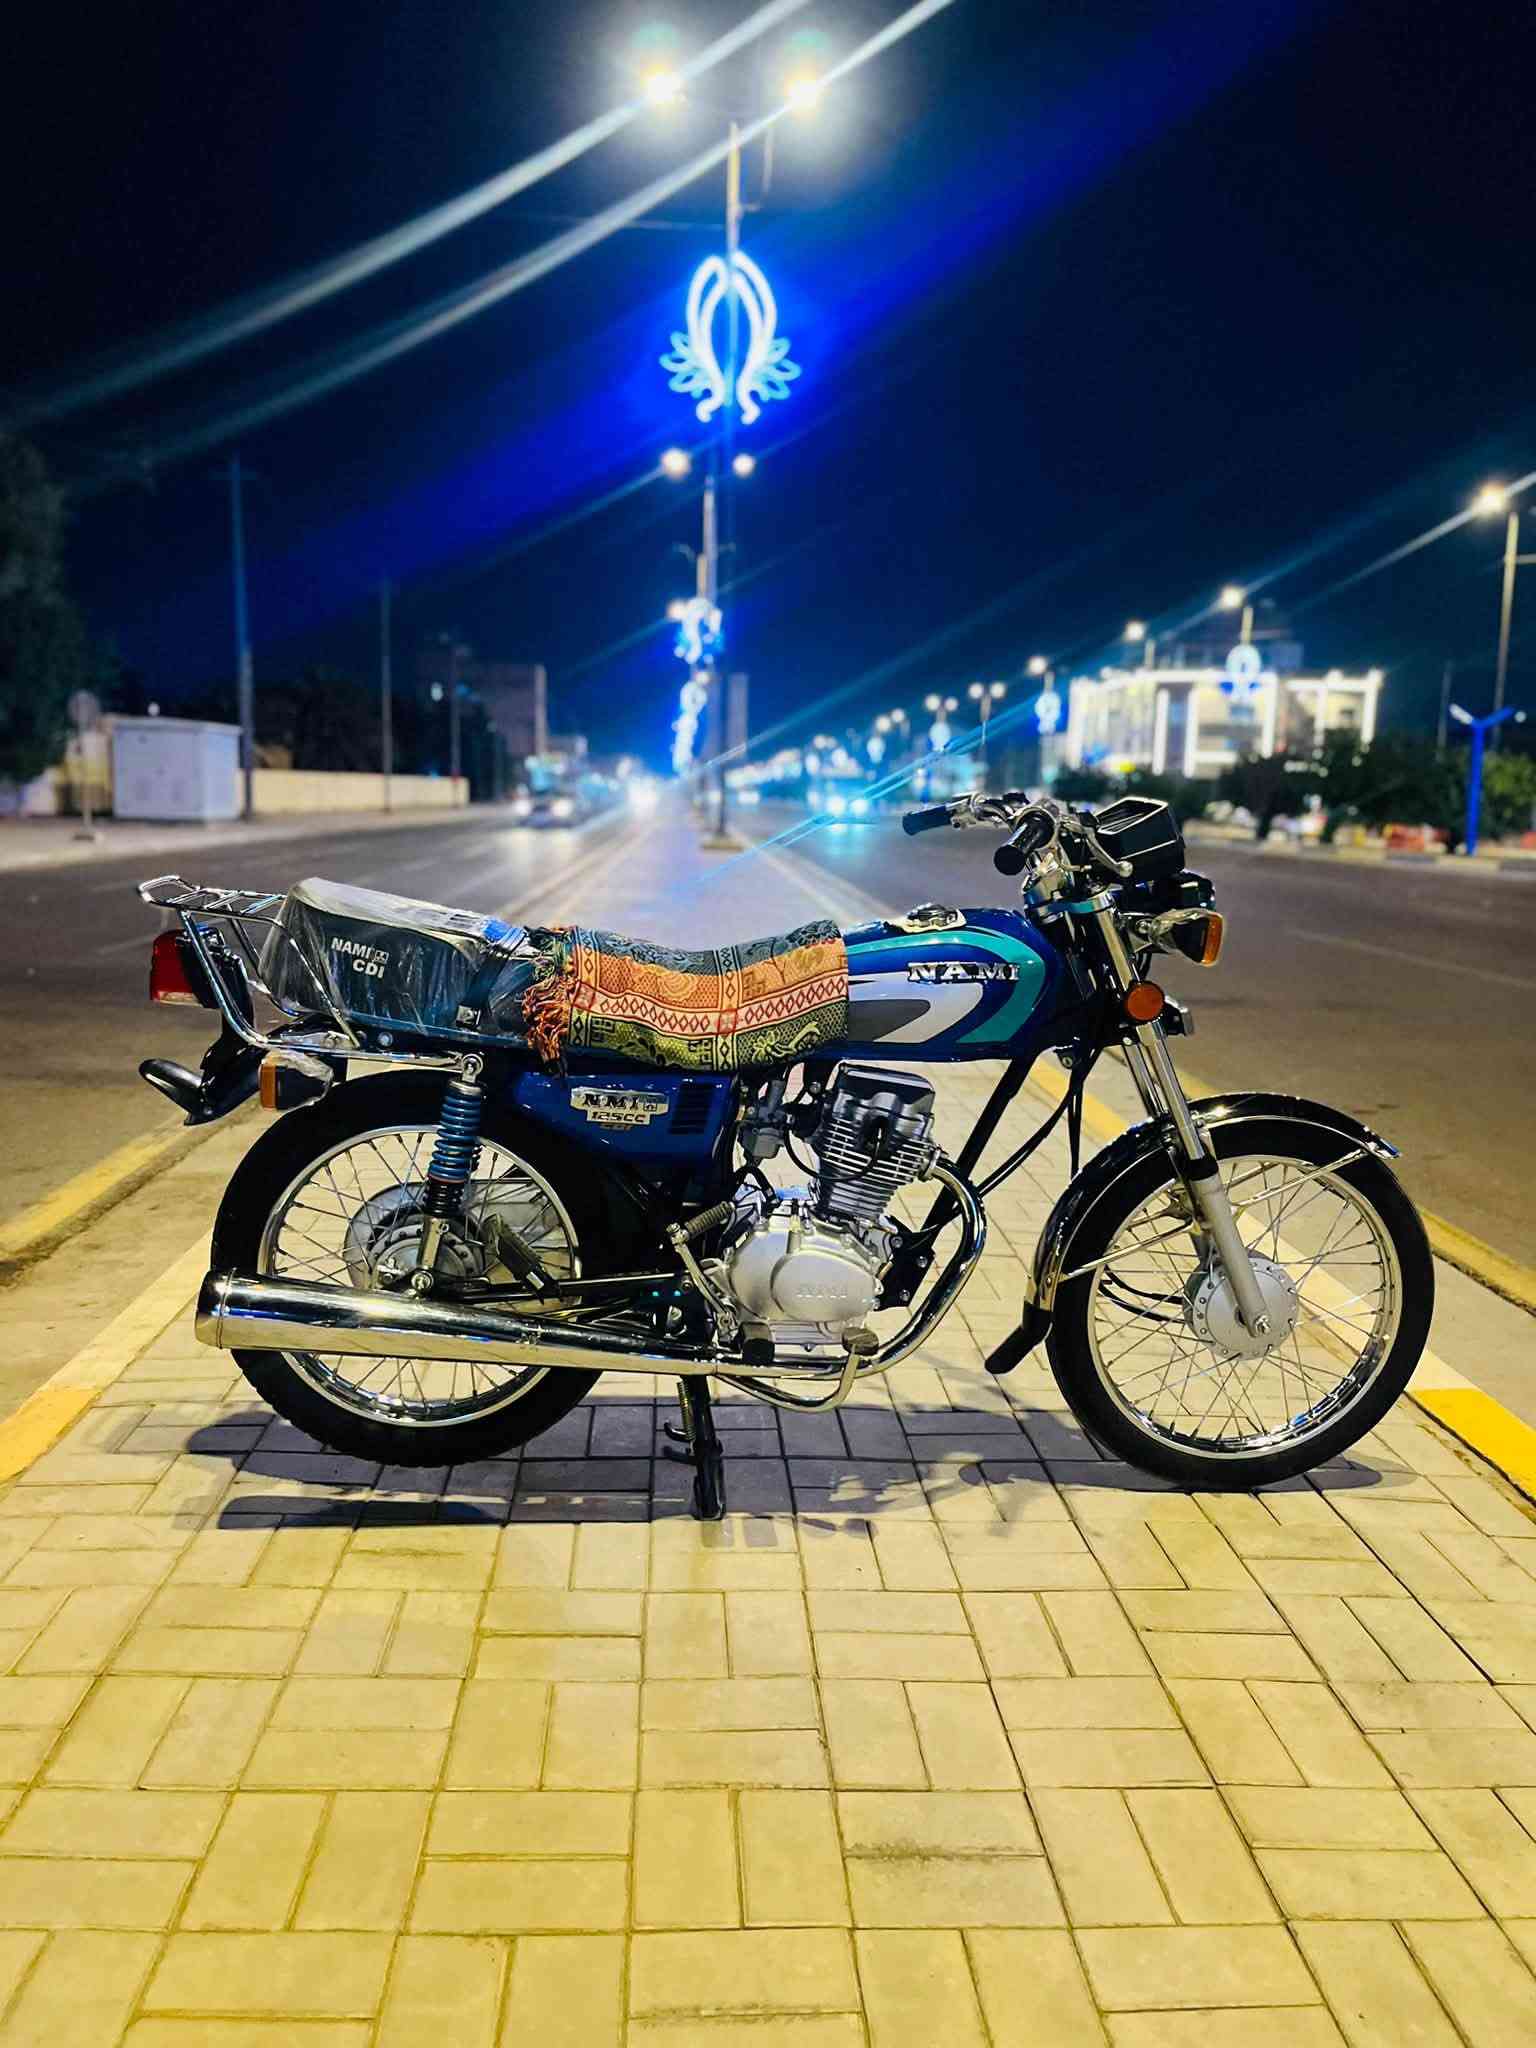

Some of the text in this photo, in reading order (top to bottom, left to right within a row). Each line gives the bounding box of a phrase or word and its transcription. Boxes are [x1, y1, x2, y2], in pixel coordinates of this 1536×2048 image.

[331, 937, 374, 959] NAMI
[353, 959, 385, 978] CDI
[908, 961, 1020, 982] NAMI
